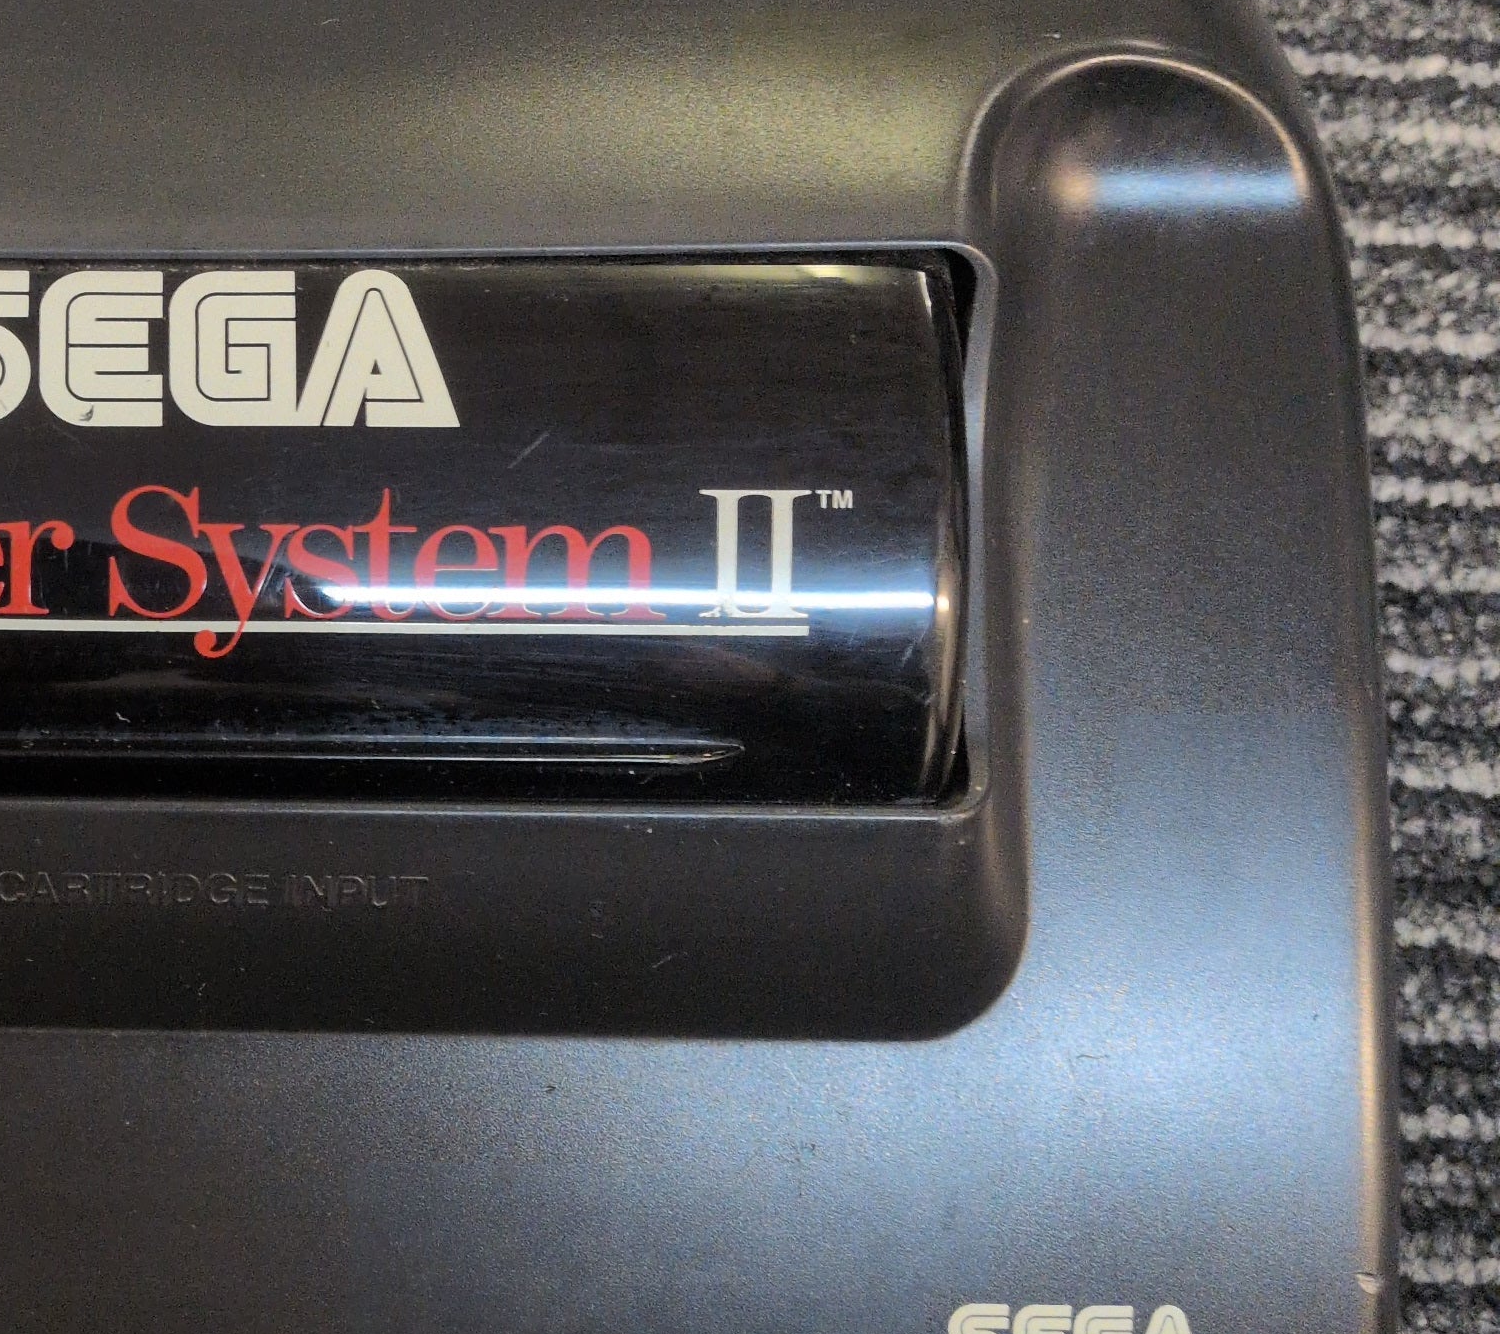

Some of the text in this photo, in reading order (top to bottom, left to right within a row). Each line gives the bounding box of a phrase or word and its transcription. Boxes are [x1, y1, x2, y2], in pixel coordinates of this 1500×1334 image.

[109, 484, 667, 657] System
[699, 489, 813, 618] II
[285, 874, 430, 908] INPUT
